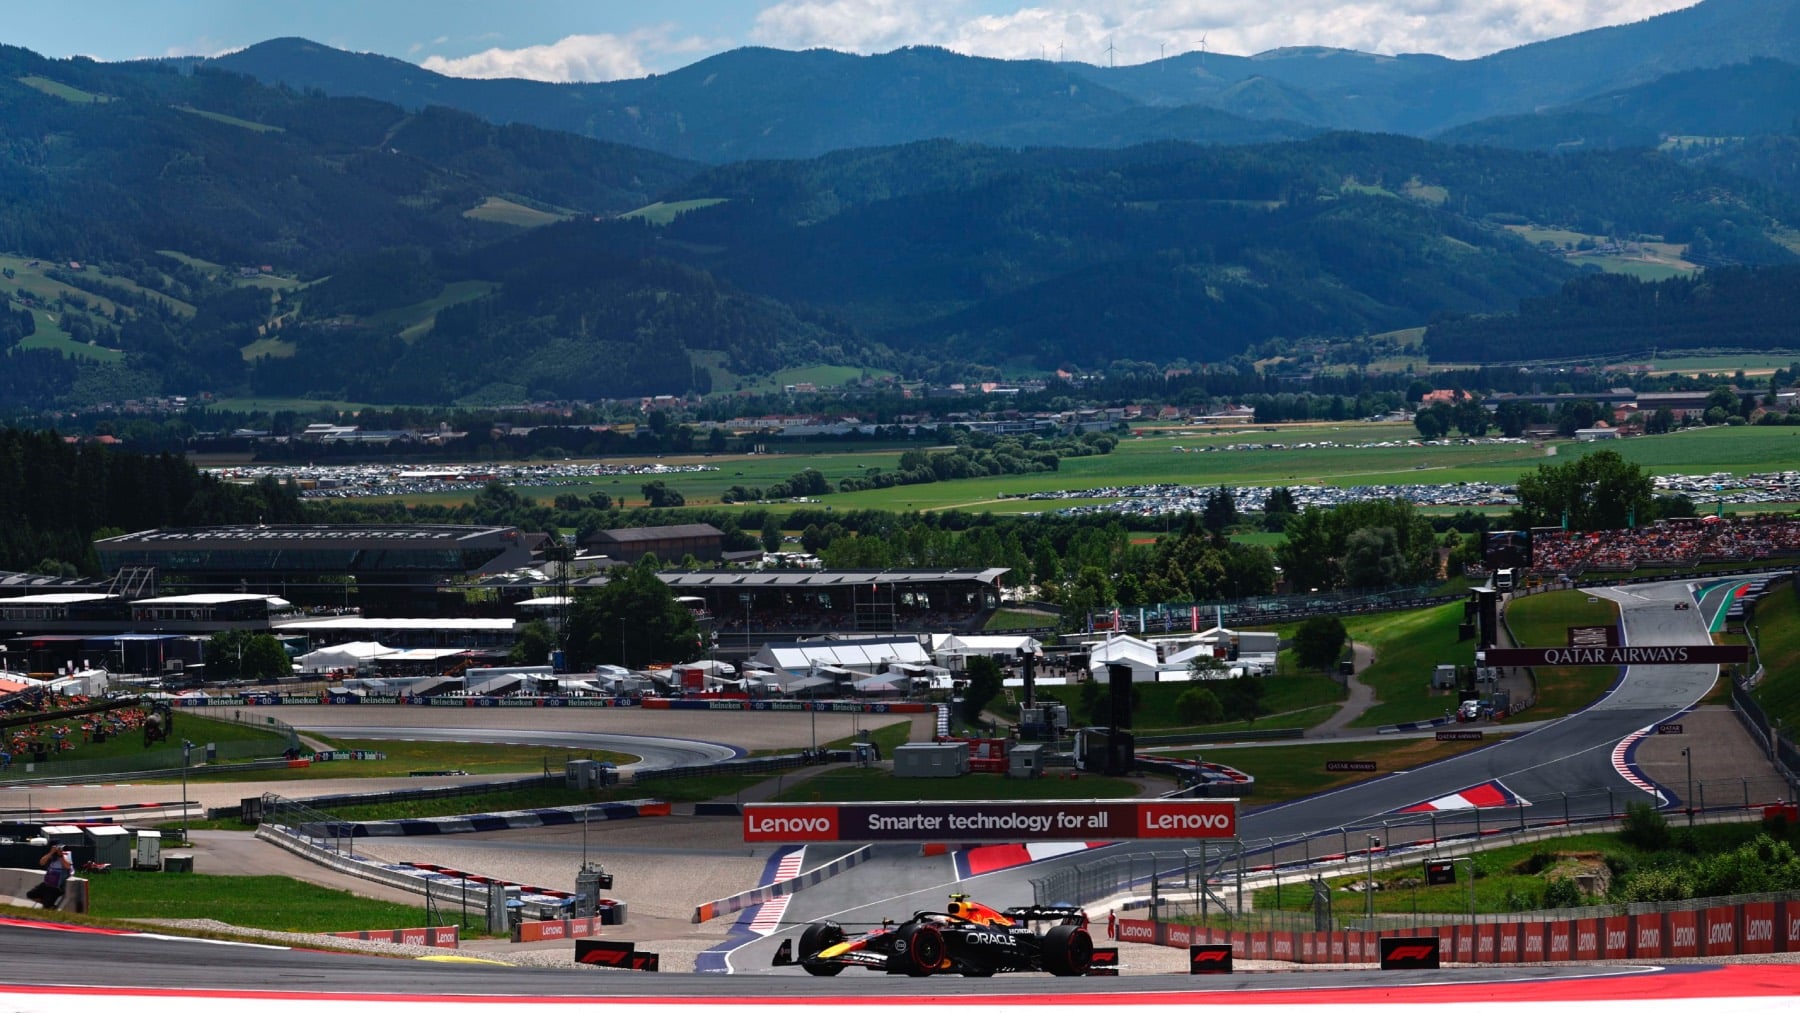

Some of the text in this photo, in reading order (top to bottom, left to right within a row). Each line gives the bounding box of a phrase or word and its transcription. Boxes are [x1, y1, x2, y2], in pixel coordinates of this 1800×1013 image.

[1544, 647, 1689, 664] QATAR AIRWAYS
[207, 698, 244, 706] Heineken
[709, 701, 740, 710] Heineken
[772, 702, 802, 710] Heineken
[748, 815, 830, 833] Lenovo
[868, 812, 1108, 832] Smarter technology for all
[1146, 811, 1229, 829] Lenovo
[543, 924, 562, 936] Lenovo
[572, 924, 588, 934] Lenovo
[1121, 924, 1152, 938] Lenovo
[1638, 924, 1660, 948] Lenovo
[1672, 922, 1696, 947] Lenovo
[1708, 920, 1732, 944] Lenovo
[1746, 914, 1772, 940] Lenovo
[403, 933, 425, 944] Lenovo
[966, 932, 1016, 946] ORACLE
[1500, 931, 1516, 952] Lenovo
[1526, 931, 1542, 952] Lenovo
[1552, 930, 1568, 952] Lenovo
[1578, 928, 1596, 951] Lenovo
[1606, 927, 1626, 950] Lenovo
